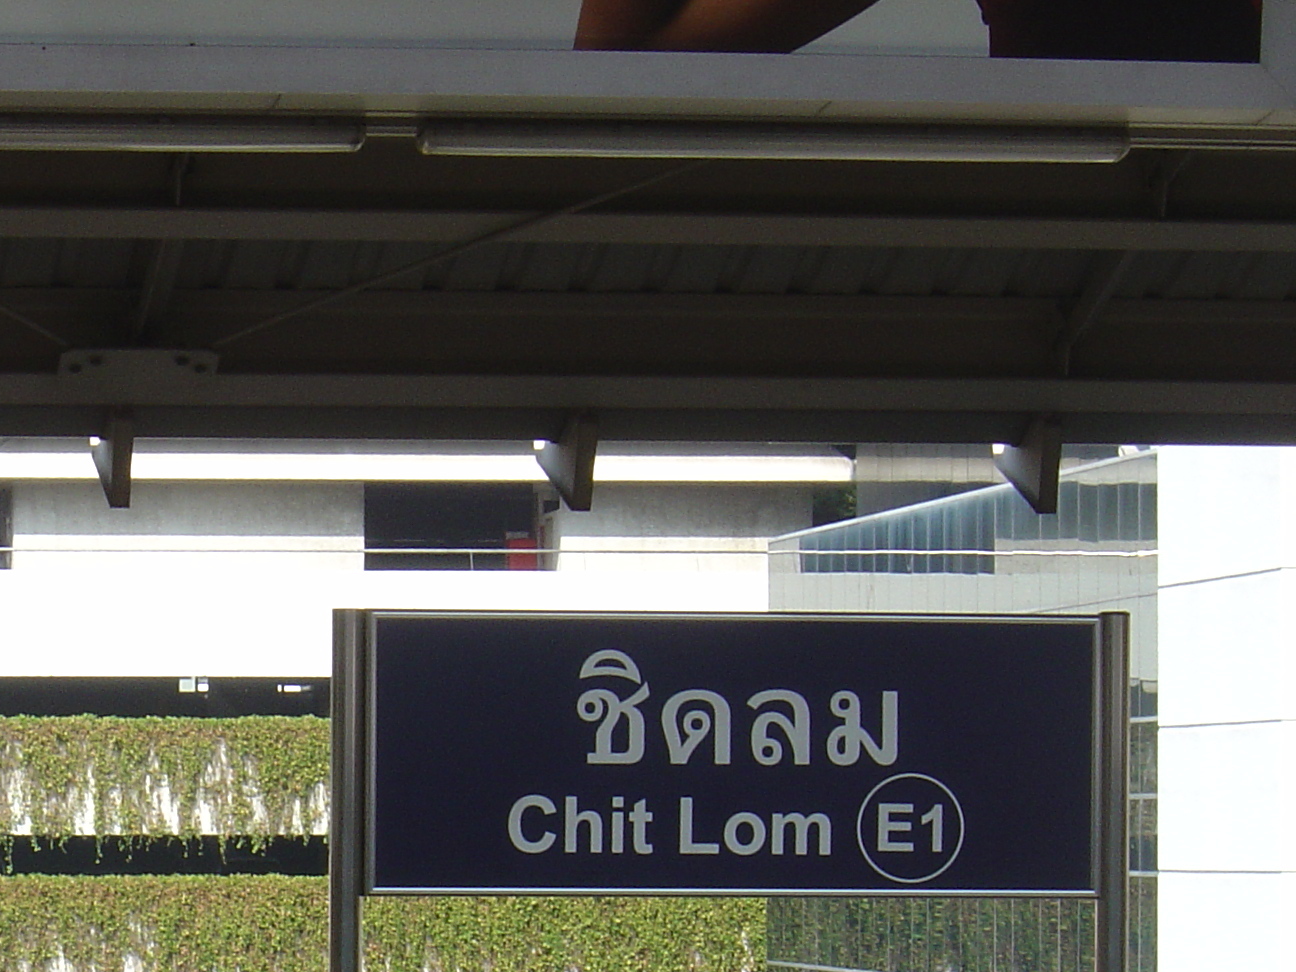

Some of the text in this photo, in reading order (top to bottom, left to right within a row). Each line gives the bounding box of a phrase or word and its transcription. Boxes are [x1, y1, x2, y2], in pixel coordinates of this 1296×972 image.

[577, 649, 898, 766] ชิดลม
[507, 794, 943, 856] Chit Lom E1
